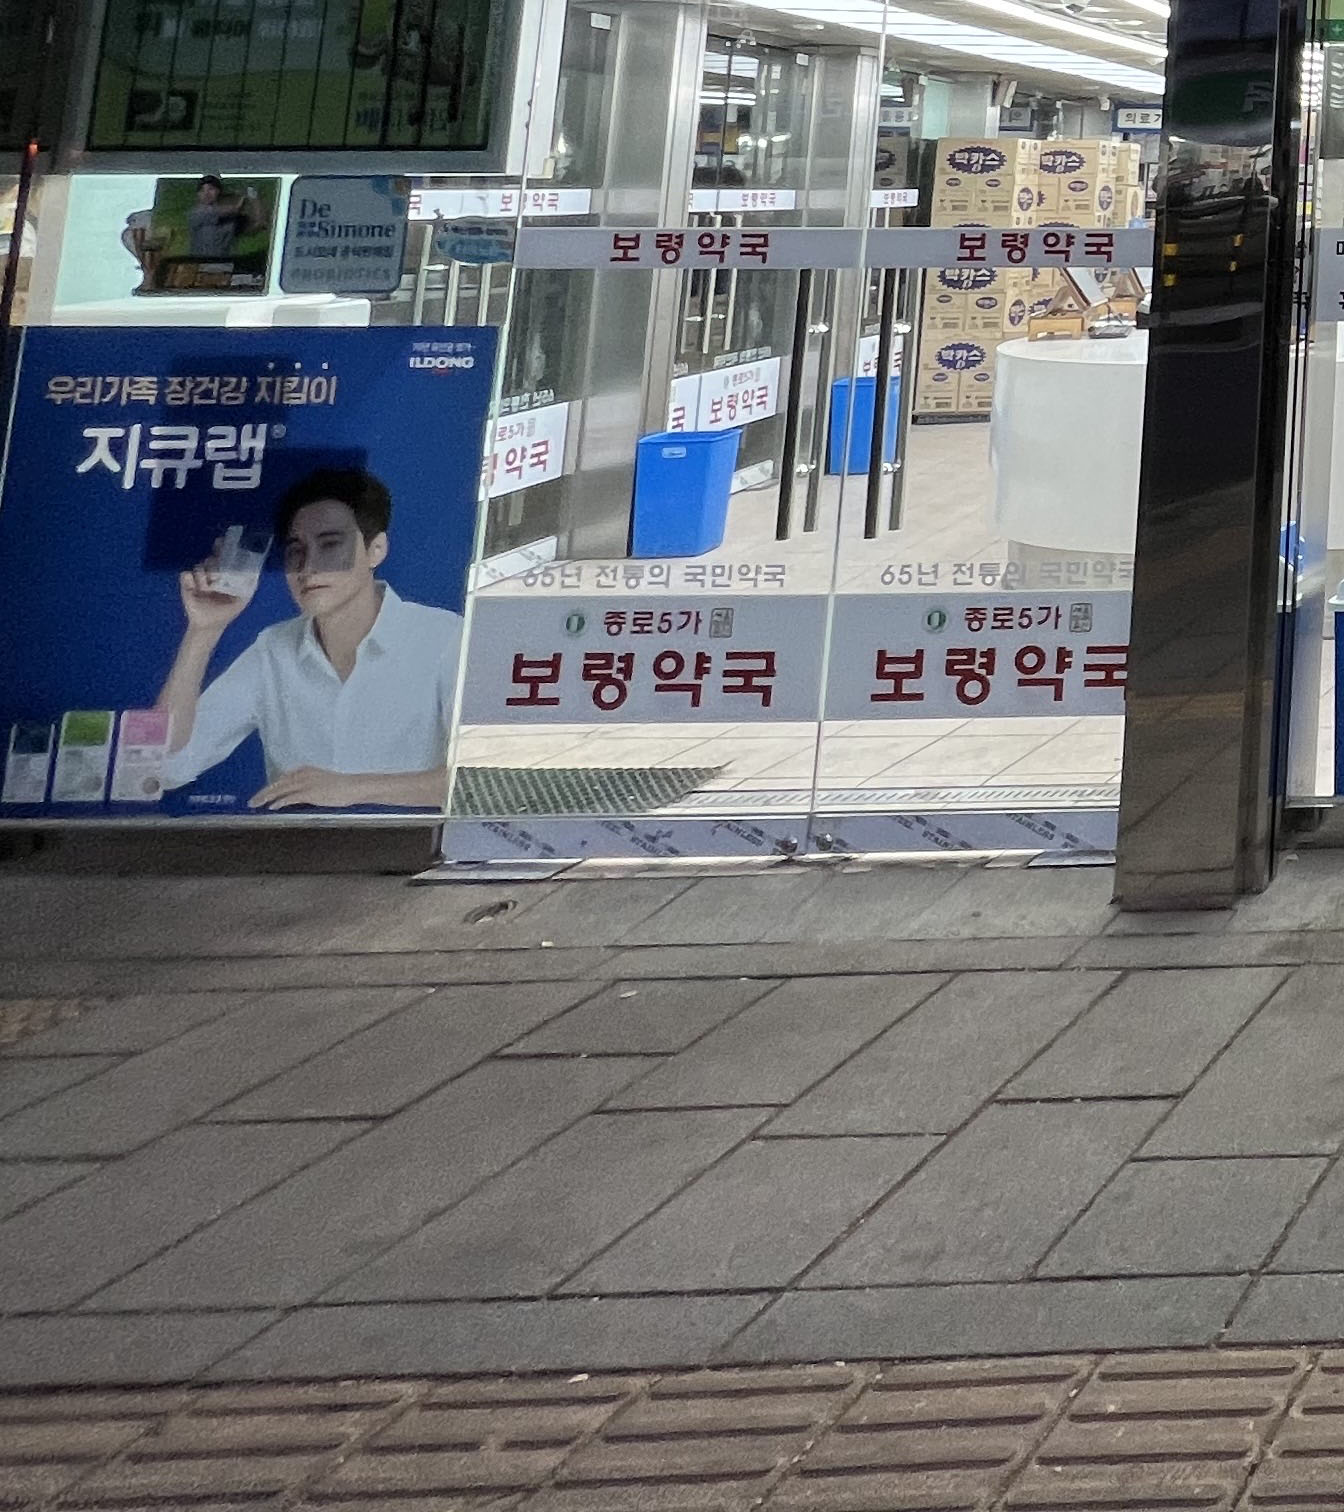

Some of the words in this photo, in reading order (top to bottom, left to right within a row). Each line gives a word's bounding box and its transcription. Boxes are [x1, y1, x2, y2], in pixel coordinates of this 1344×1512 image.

[610, 232, 769, 265] 보령약국
[957, 232, 1114, 263] 보령약국
[409, 356, 475, 369] ILDONG
[45, 375, 157, 407] 우리가족
[163, 375, 248, 407] 장건강
[254, 374, 338, 407] 지킴이
[709, 386, 768, 424] 보령약국
[76, 423, 269, 490] 지큐랩
[522, 566, 583, 589] 65년
[595, 563, 671, 589] 전통의
[684, 563, 786, 588] 국민약국
[880, 562, 940, 586] 65년
[952, 561, 1026, 588] 전통의
[603, 610, 703, 637] 종로5가
[964, 606, 1062, 633] 종로5가
[506, 649, 778, 710] 보령약국
[869, 643, 1131, 706] 보령약국
